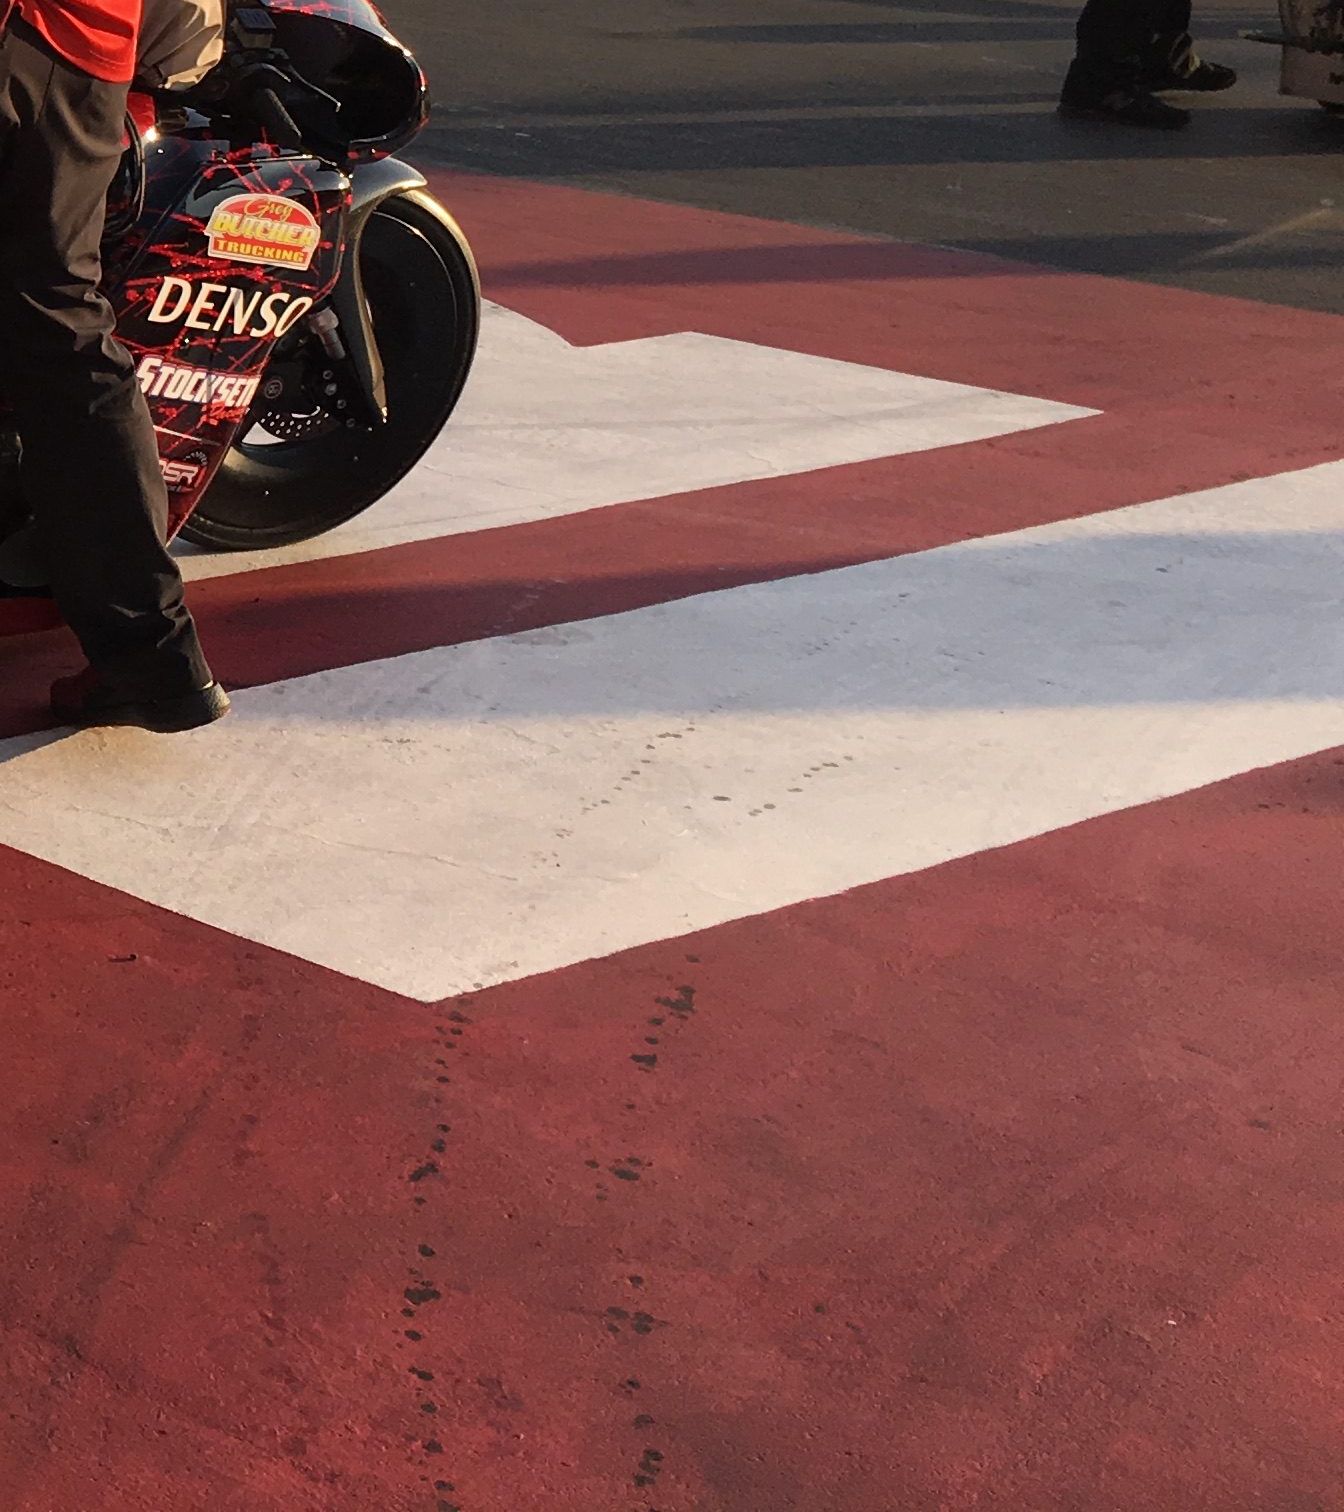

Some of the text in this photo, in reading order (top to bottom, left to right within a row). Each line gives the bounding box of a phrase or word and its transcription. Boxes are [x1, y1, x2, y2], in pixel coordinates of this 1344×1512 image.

[244, 197, 293, 222] Greg
[213, 212, 316, 249] BUTCHER
[216, 239, 305, 263] TRUCKING
[148, 276, 313, 338] DENSO
